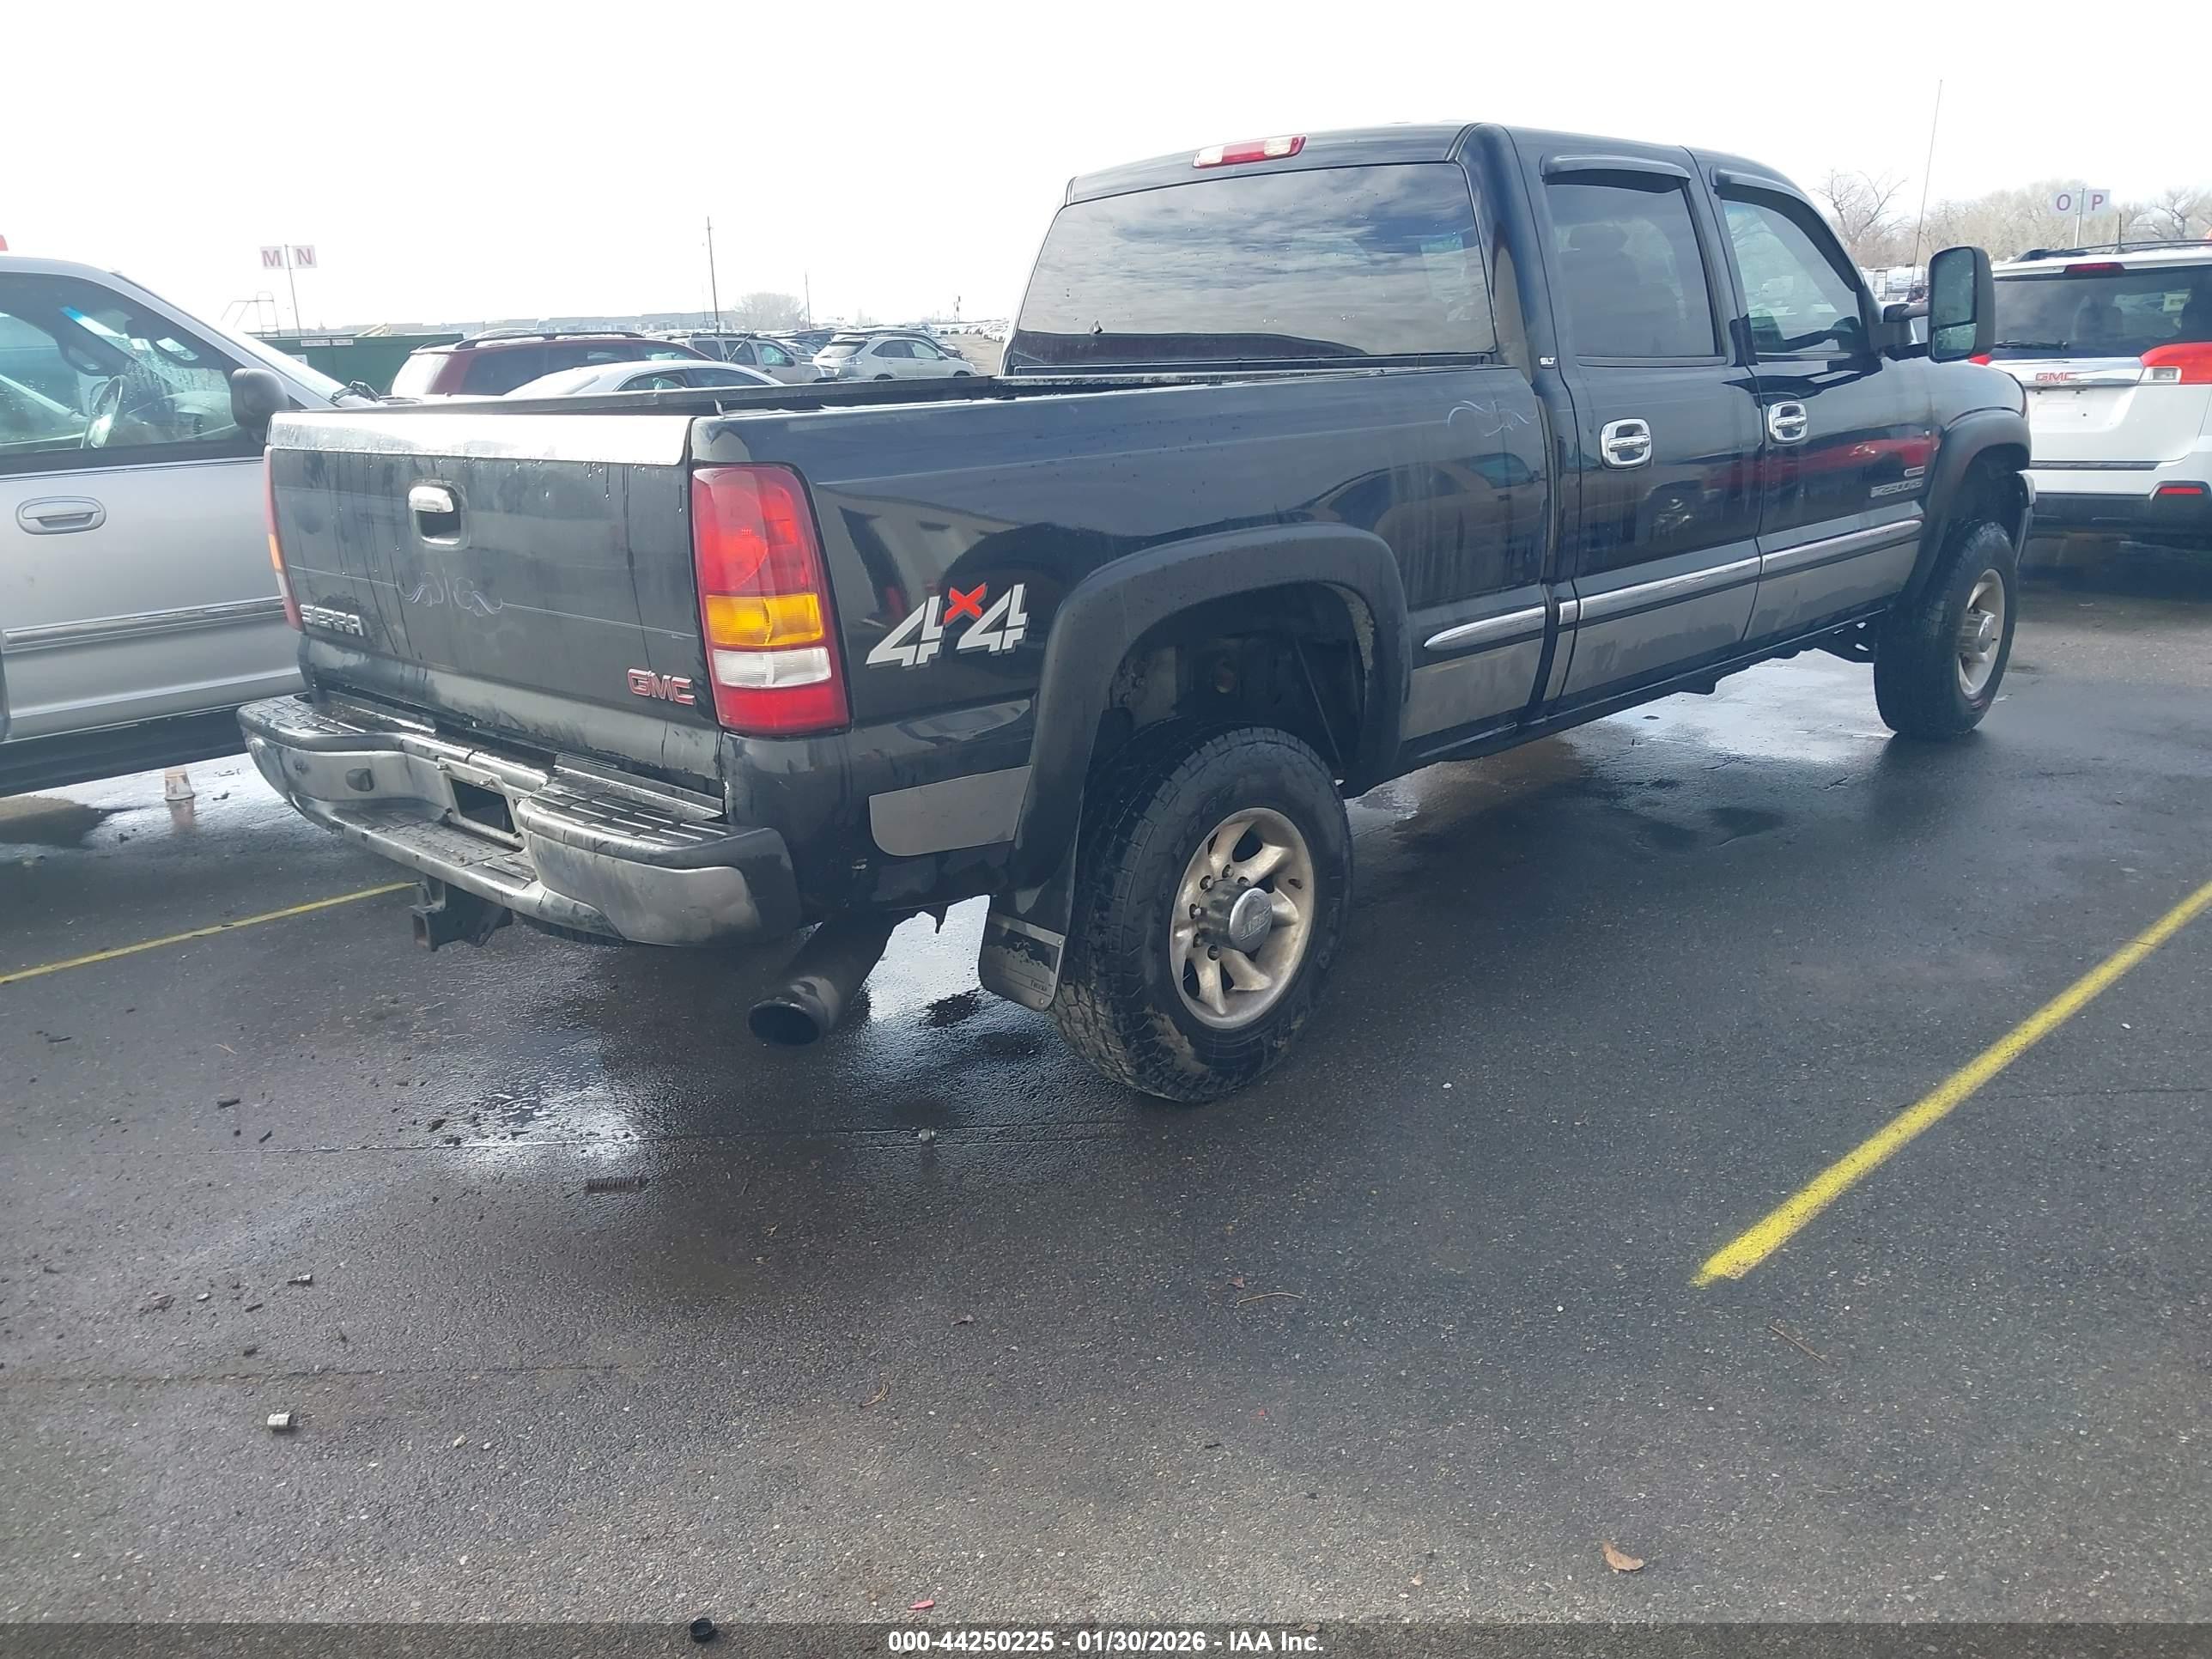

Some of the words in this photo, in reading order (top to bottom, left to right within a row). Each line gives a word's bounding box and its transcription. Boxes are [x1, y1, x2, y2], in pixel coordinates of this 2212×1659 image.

[2057, 194, 2071, 211] O
[2092, 194, 2104, 211] P
[261, 250, 283, 267] M
[296, 248, 313, 265] N
[2036, 372, 2077, 380] GMC
[300, 604, 364, 636] SIERRA
[627, 668, 696, 706] GMC
